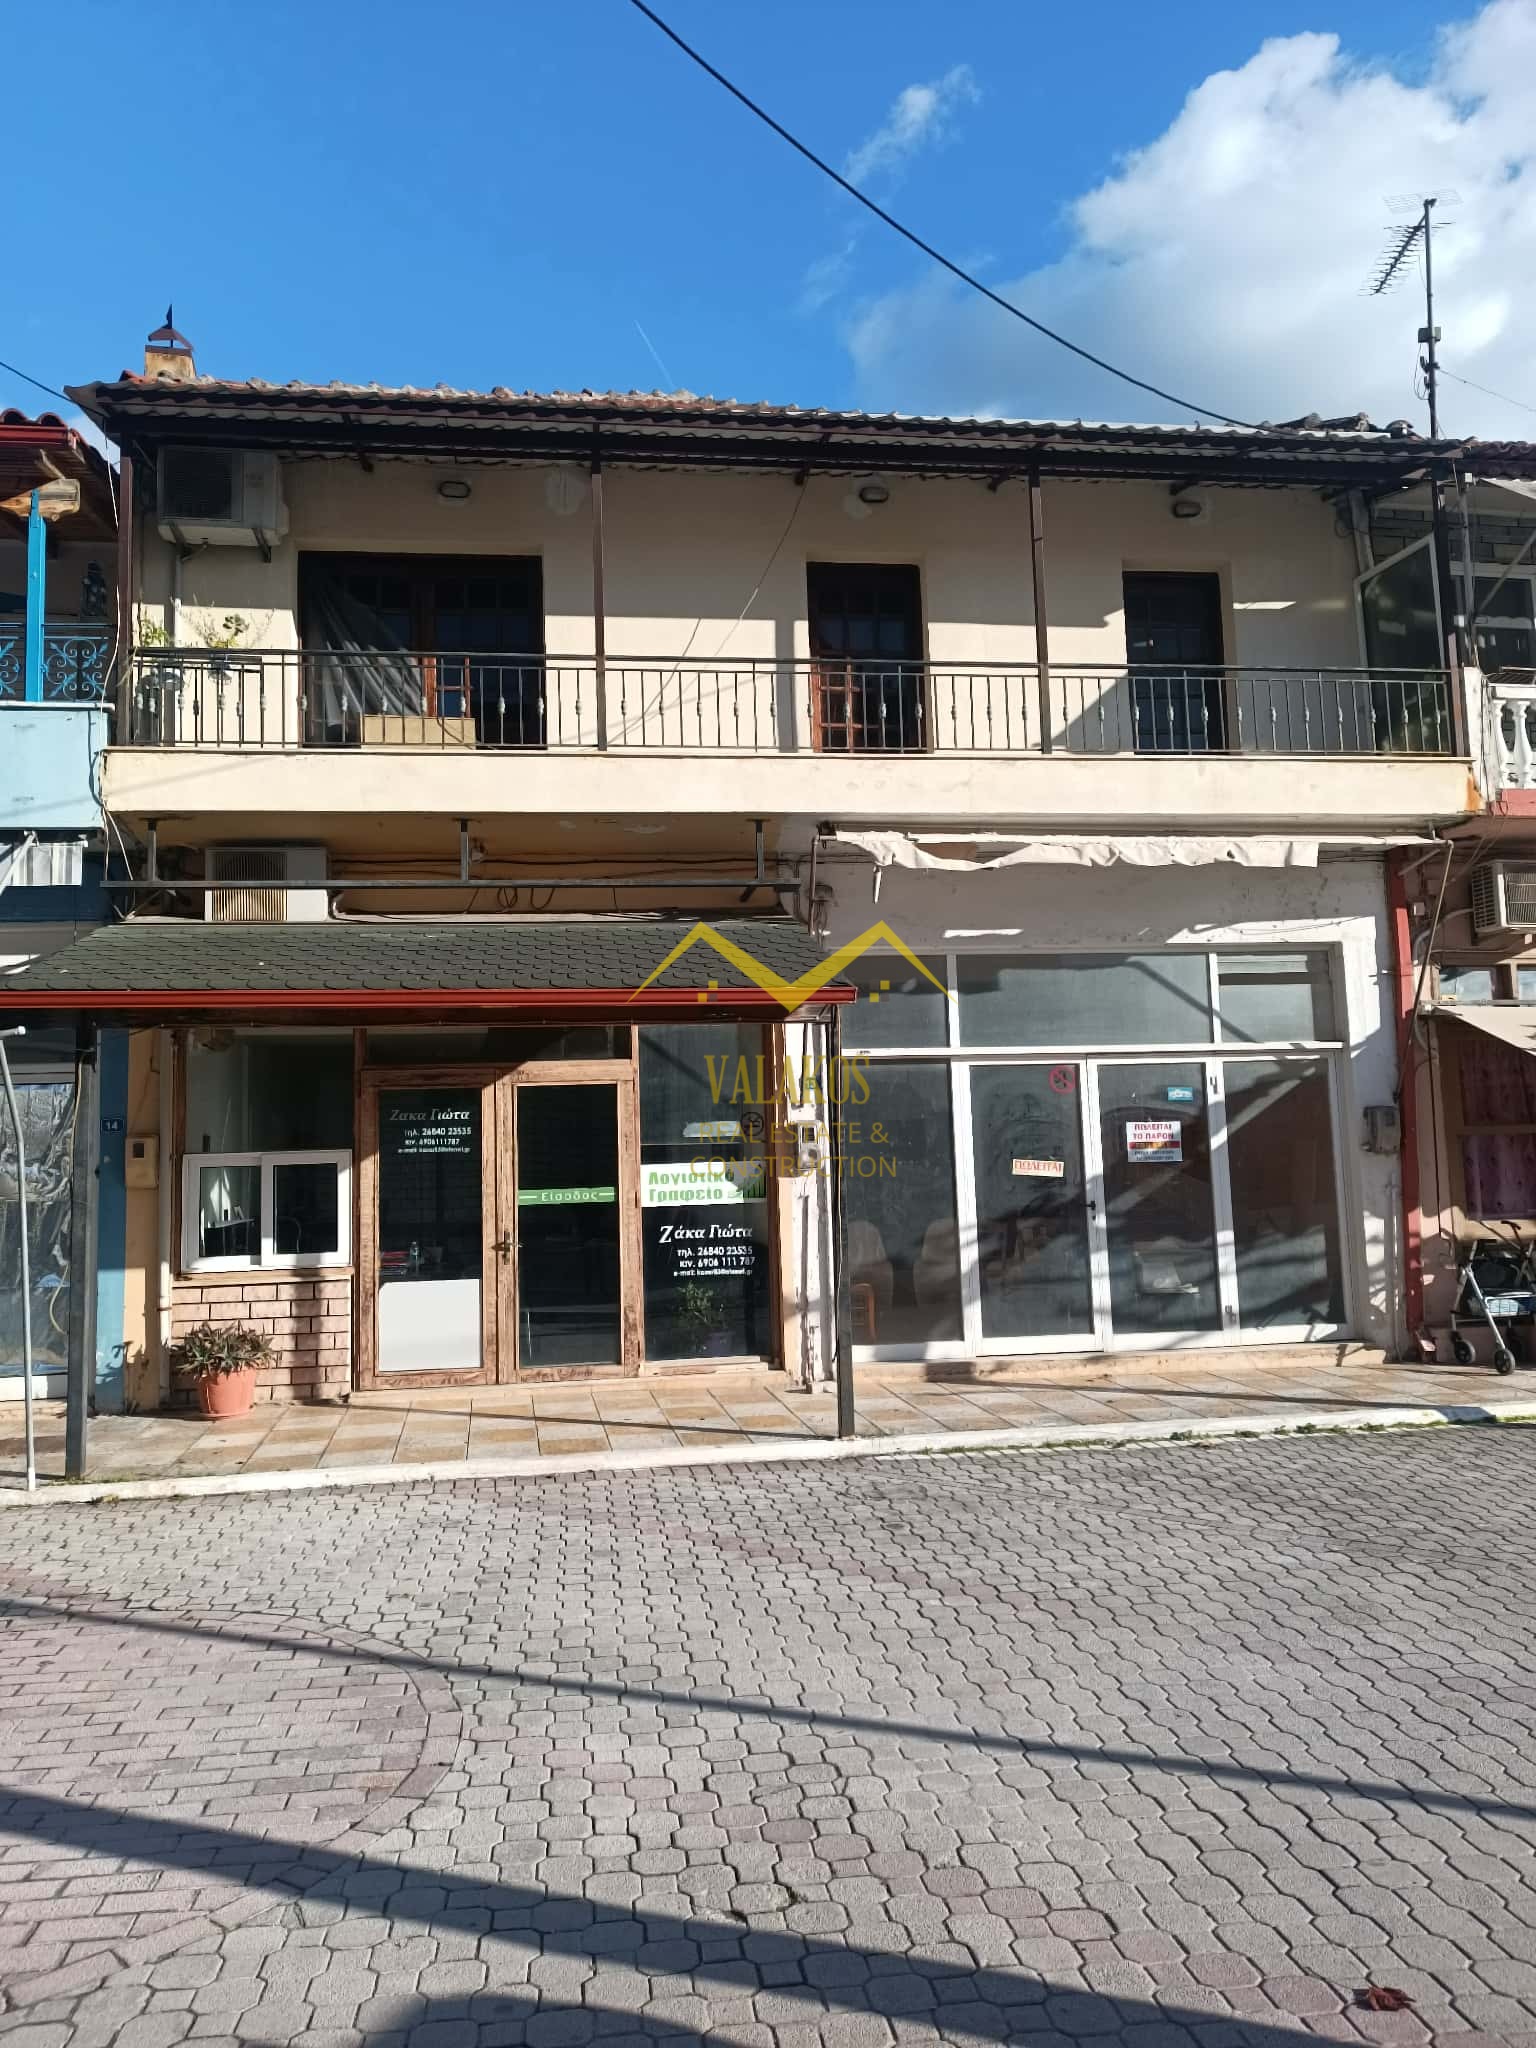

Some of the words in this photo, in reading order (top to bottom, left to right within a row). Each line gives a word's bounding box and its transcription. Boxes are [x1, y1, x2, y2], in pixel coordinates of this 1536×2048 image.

[430, 1107, 472, 1121] Γιώτα
[541, 1190, 598, 1202] Είσοδος
[658, 1224, 705, 1244] Ζάκα
[709, 1224, 752, 1238] Γιώτα
[677, 1247, 695, 1258] τηλ.
[697, 1246, 725, 1256] 26840
[726, 1245, 753, 1255] 23535
[697, 1258, 719, 1268] 6906
[722, 1257, 737, 1267] 111
